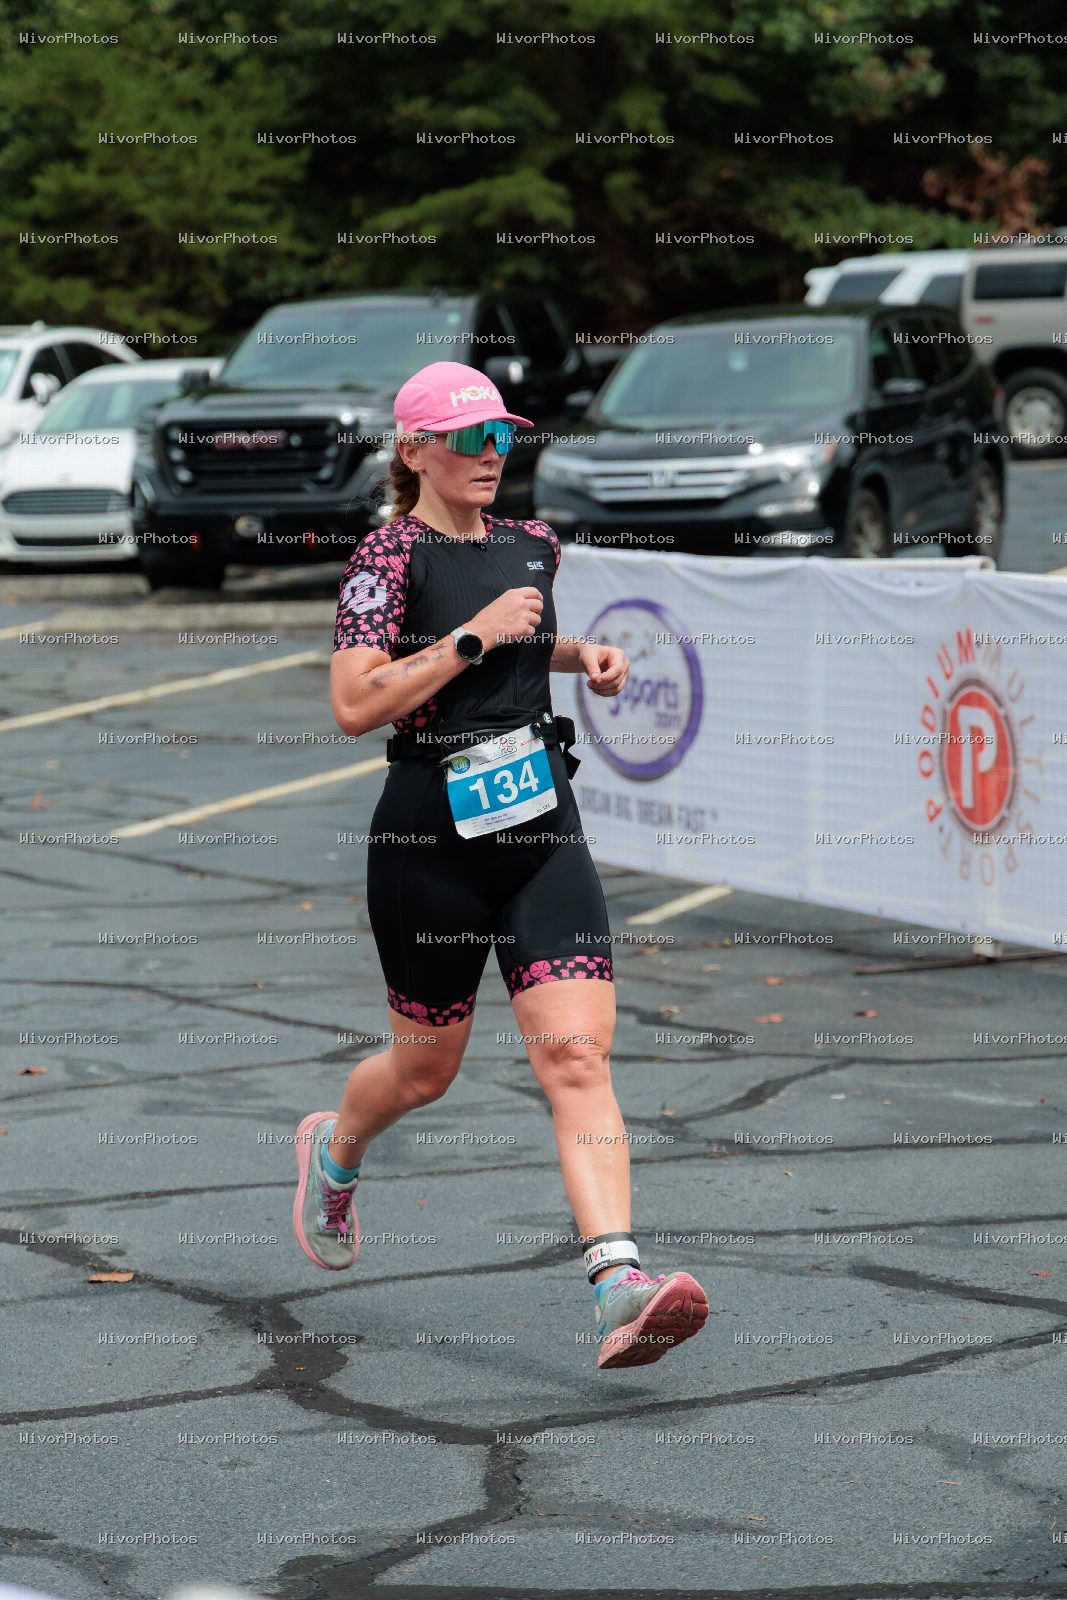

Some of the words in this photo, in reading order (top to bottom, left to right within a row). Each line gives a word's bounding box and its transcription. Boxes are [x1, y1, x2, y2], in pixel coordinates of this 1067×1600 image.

[917, 628, 976, 824] PODIUM
[957, 703, 998, 809] P
[468, 759, 540, 810] 134
[585, 1247, 610, 1267] MYL
